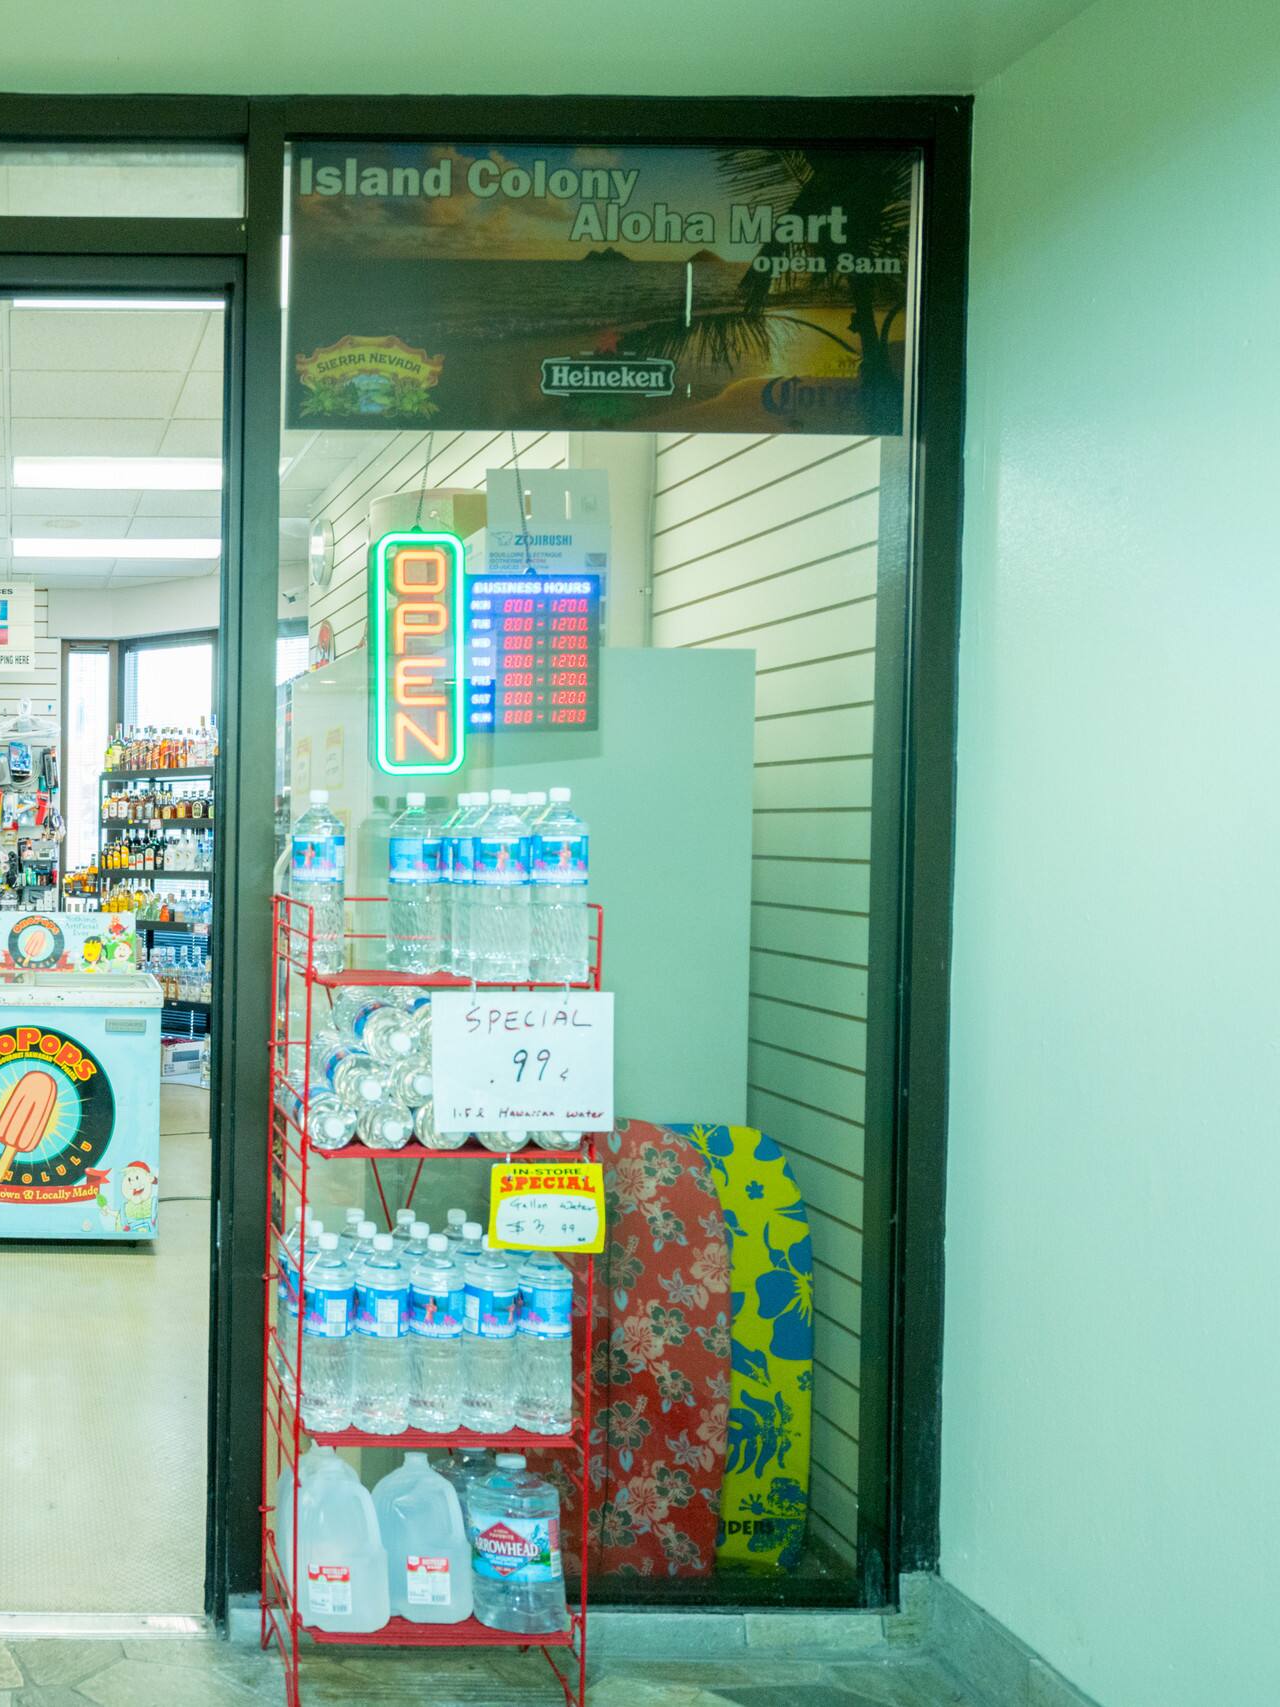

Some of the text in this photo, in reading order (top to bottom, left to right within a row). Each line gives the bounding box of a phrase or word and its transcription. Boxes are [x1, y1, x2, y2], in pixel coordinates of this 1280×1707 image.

[299, 158, 640, 205] Island Colony
[570, 203, 848, 244] Aloha Mart
[754, 252, 902, 278] open 8am
[316, 352, 422, 374] SIERRA NEVADA
[551, 366, 665, 387] Heineken
[515, 534, 572, 546] ZOJIRUSHI
[473, 582, 591, 594] BUSINESS HOURS
[15, 655, 30, 665] HERE
[394, 550, 448, 762] OPEN
[466, 1007, 592, 1034] SPECIAL
[513, 1168, 582, 1176] IN-STORE
[36, 1190, 72, 1200] Locally
[73, 1185, 99, 1197] Made
[500, 1176, 596, 1193] SPECIAL
[475, 1538, 540, 1557] ARROWHEAD
